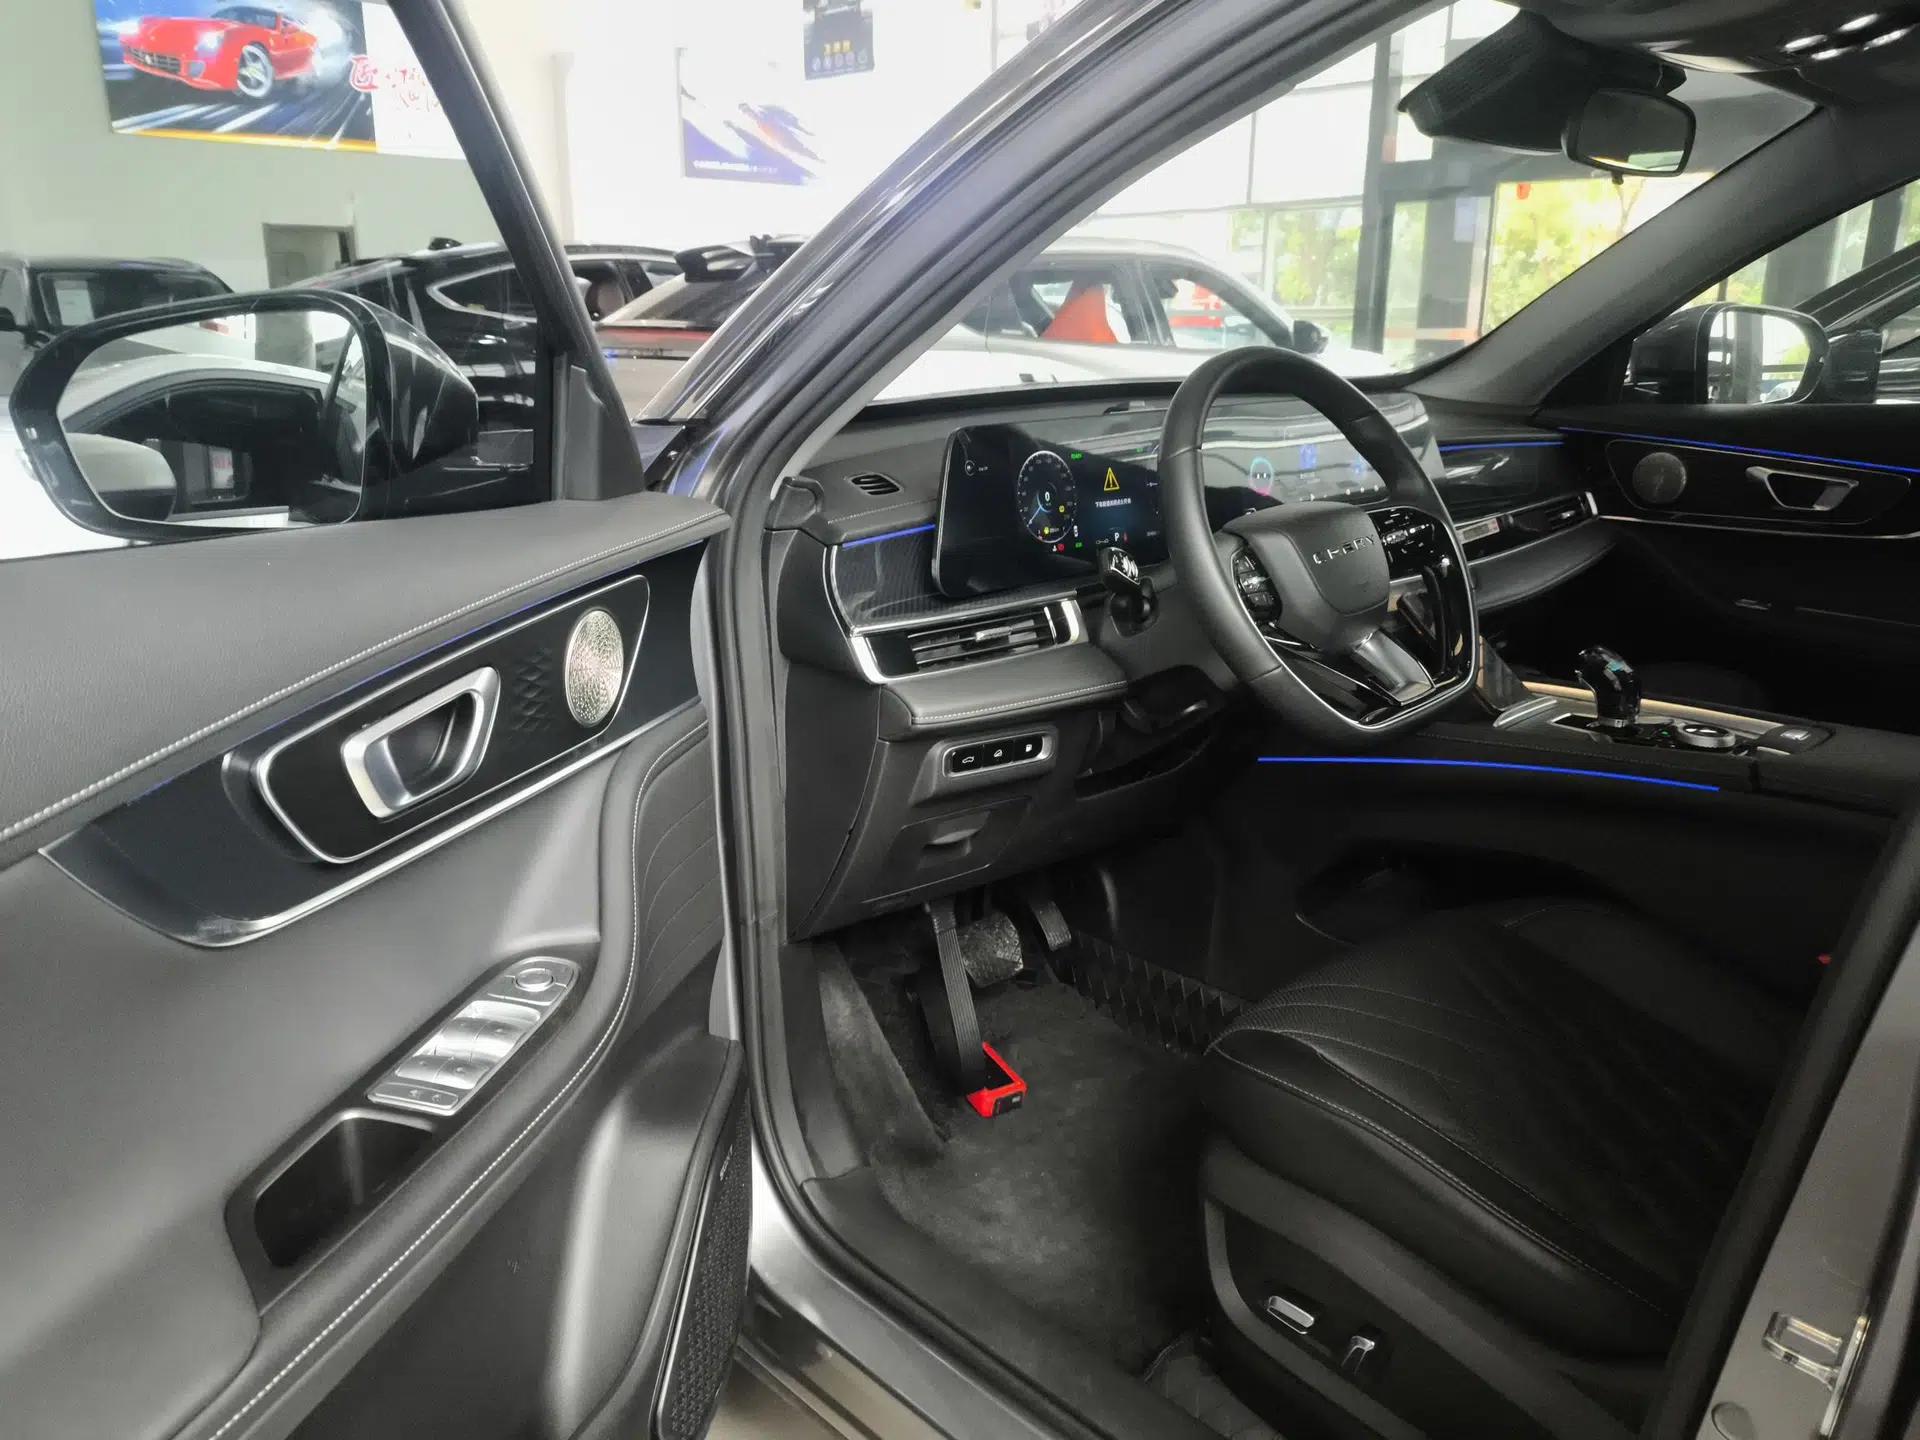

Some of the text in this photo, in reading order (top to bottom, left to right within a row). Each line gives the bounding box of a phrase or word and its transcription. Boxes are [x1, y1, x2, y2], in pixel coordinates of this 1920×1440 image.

[1044, 491, 1051, 502] 0
[1114, 532, 1120, 542] P
[1312, 534, 1375, 565] CHERY
